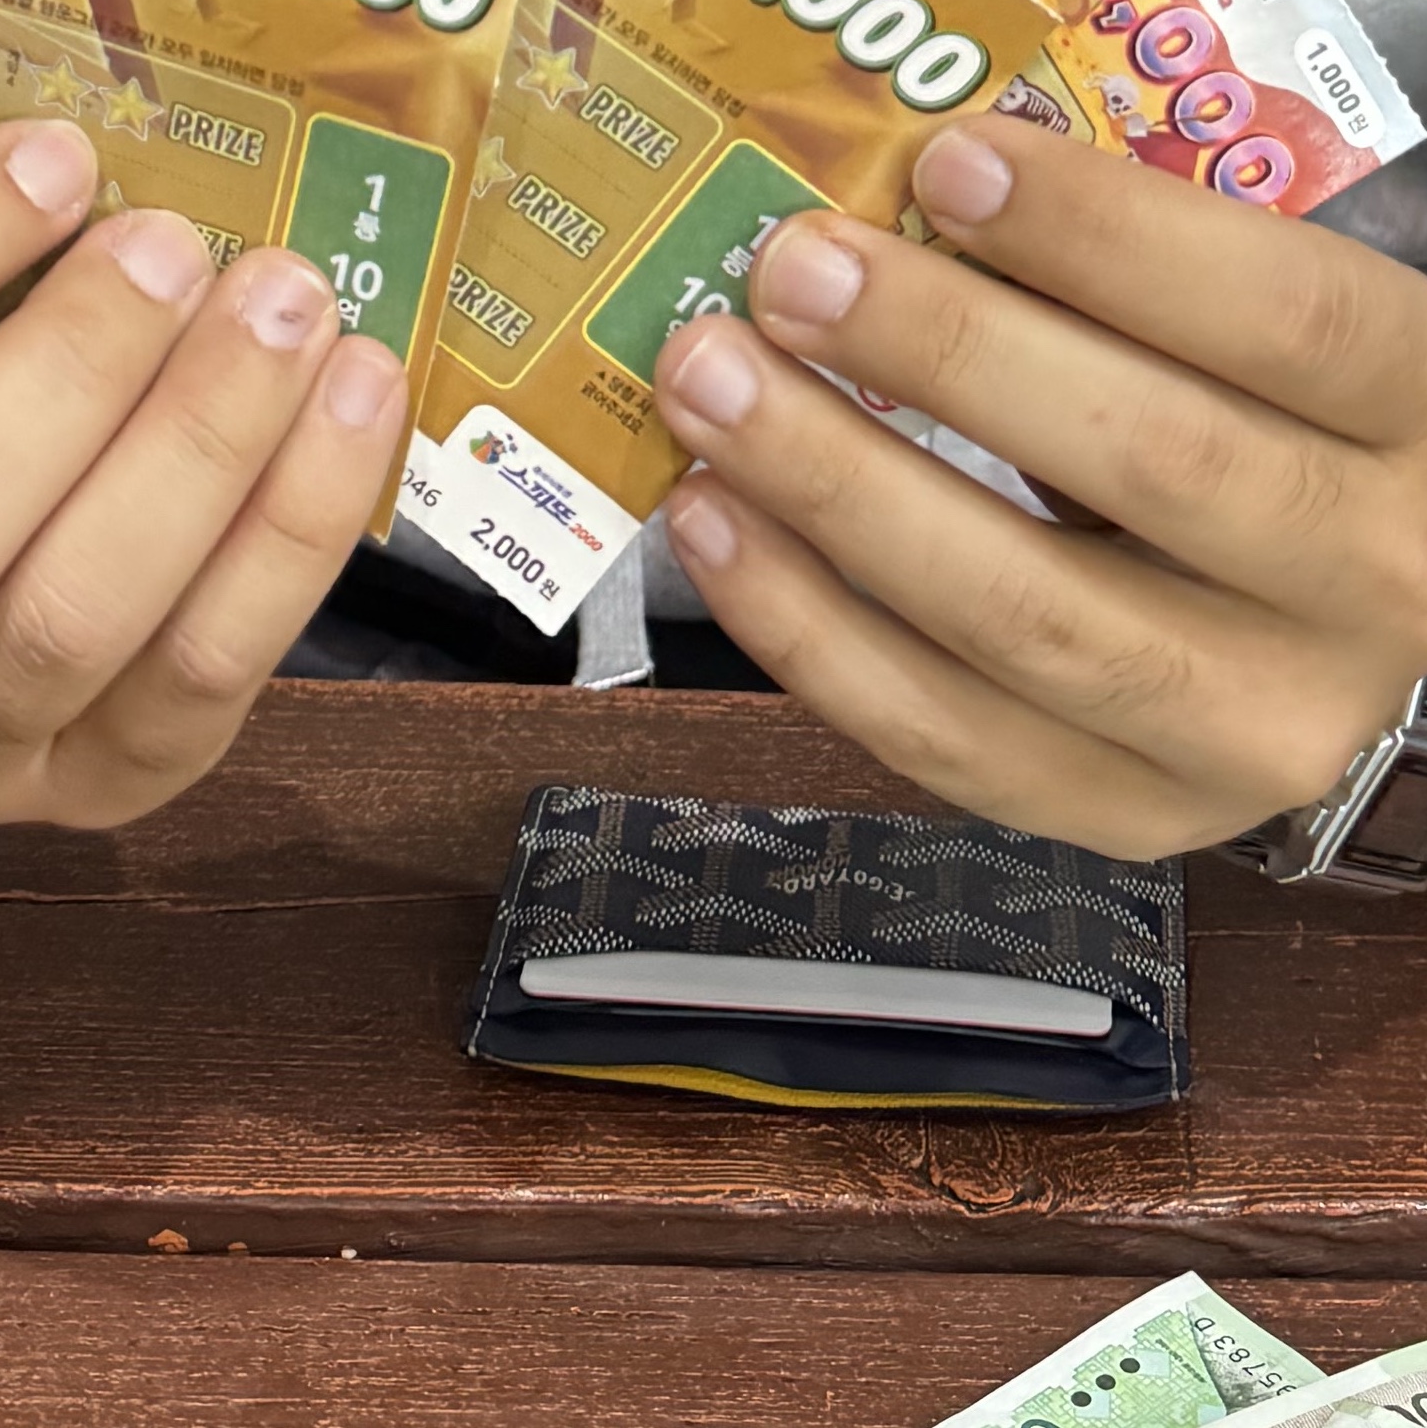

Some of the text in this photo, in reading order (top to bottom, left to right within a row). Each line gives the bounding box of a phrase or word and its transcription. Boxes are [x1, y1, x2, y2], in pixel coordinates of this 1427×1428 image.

[170, 105, 266, 165] PRIZE
[581, 85, 679, 170] PRIZE
[507, 175, 609, 260] PRIZE
